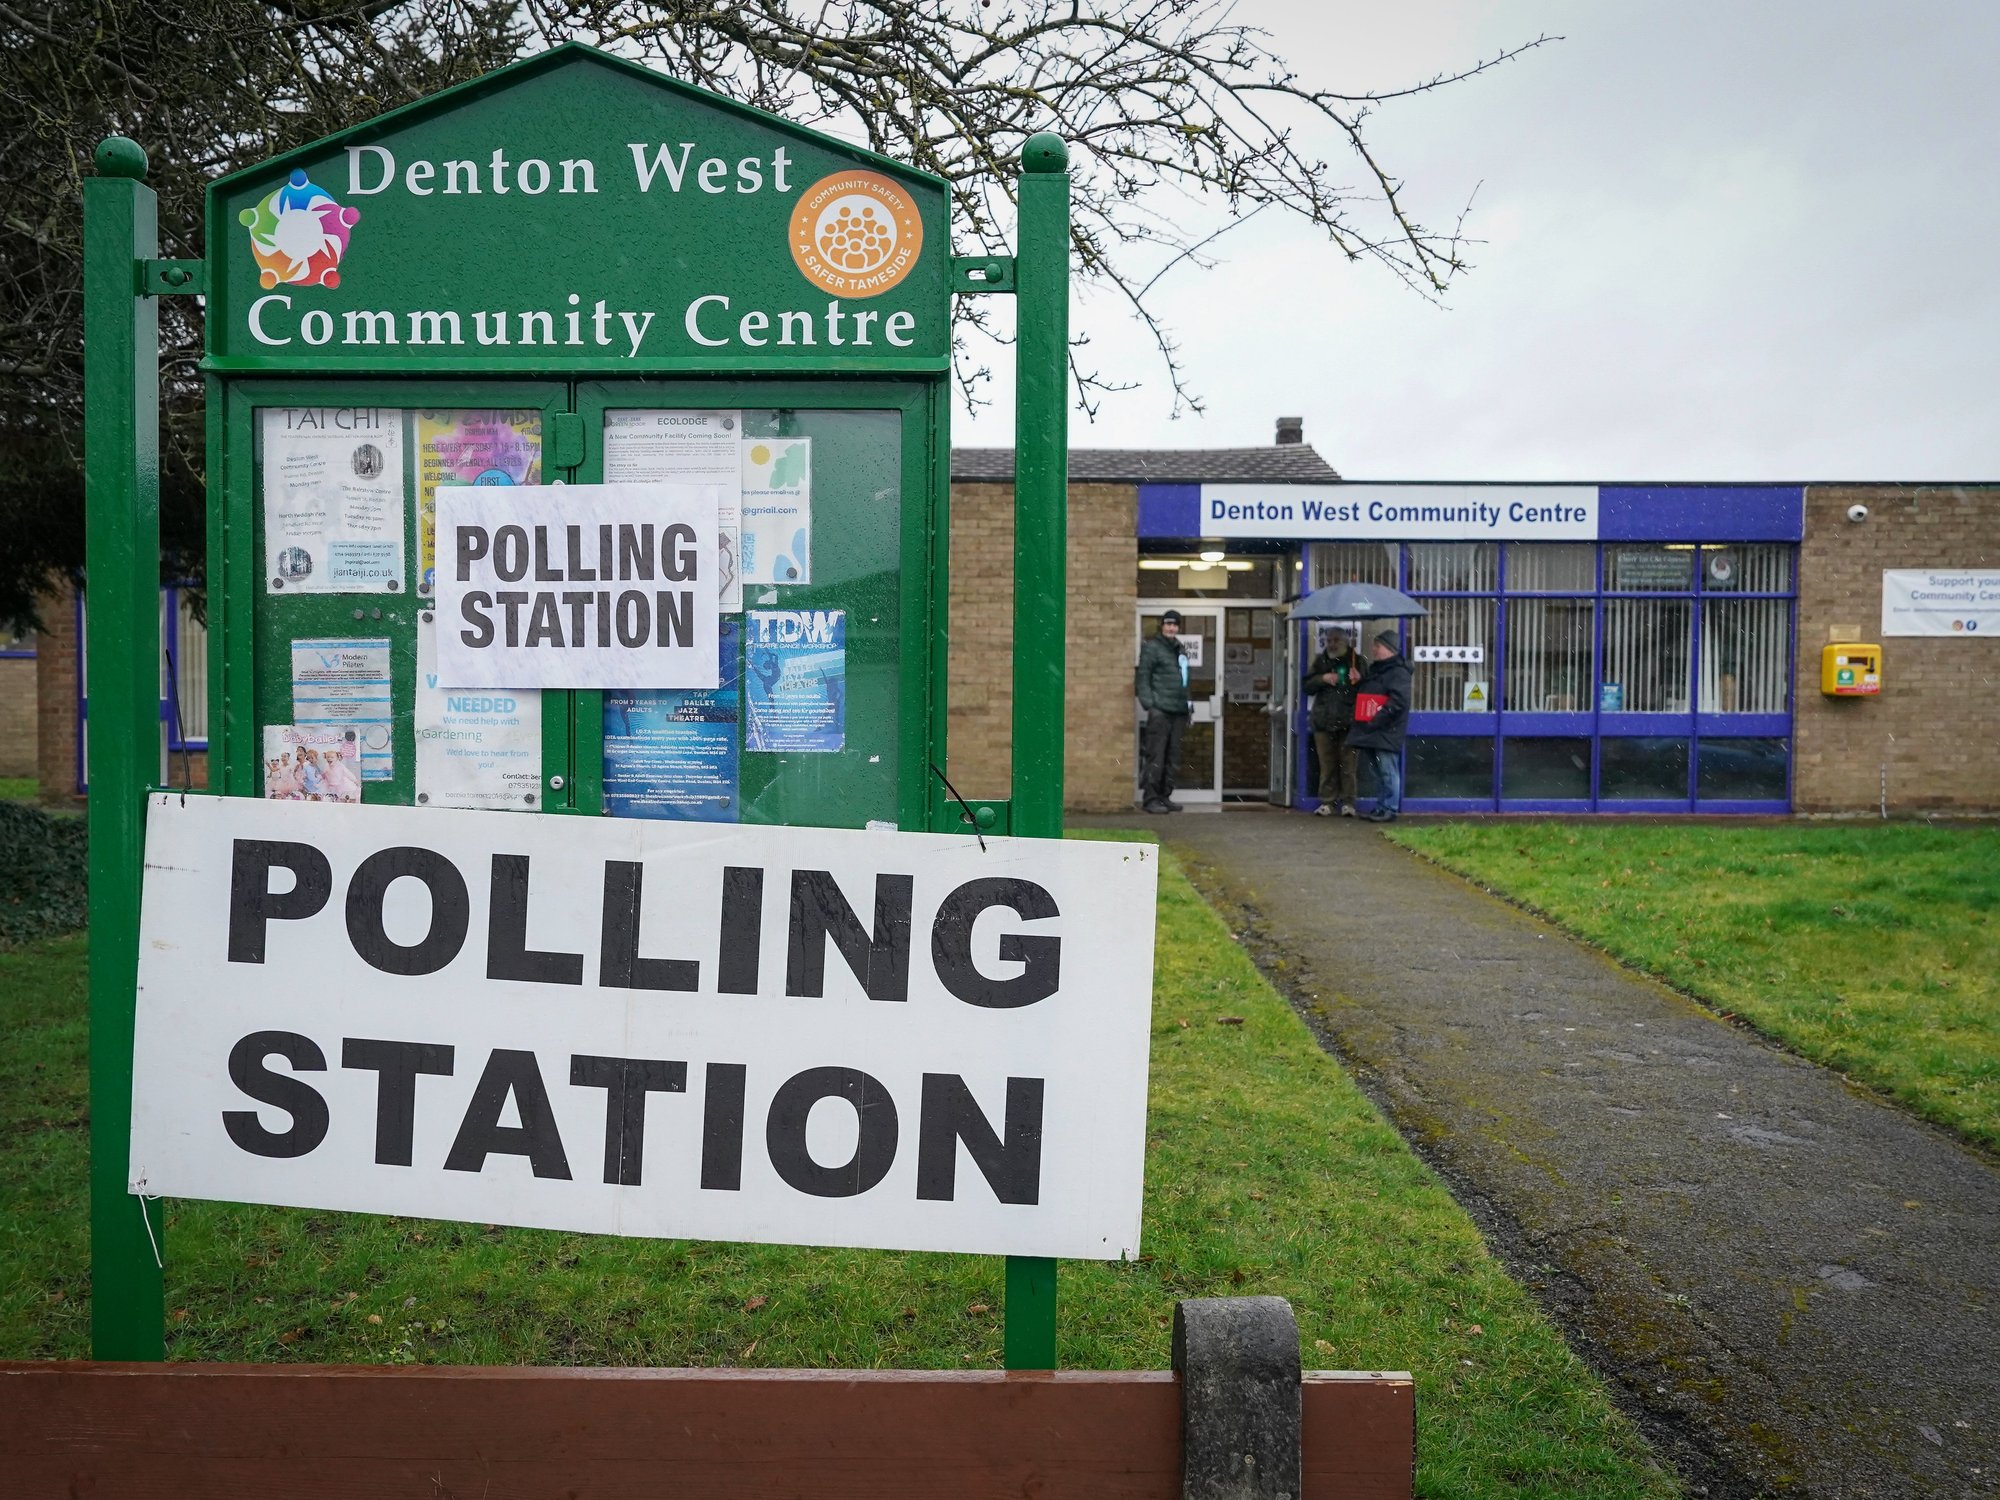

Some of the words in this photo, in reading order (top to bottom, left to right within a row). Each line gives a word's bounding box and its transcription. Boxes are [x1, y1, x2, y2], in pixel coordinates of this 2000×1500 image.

[344, 145, 598, 196] Denton
[627, 142, 793, 194] West
[810, 181, 869, 209] COMMUNITY
[872, 184, 904, 210] SAFETY
[800, 244, 810, 254] A
[805, 256, 845, 288] SAFER
[849, 247, 911, 290] TAMESIDE
[248, 294, 655, 358] Community
[685, 295, 916, 347] Centre
[335, 408, 379, 430] CHI
[657, 417, 708, 426] ECOLODGE
[665, 432, 686, 440] Facility
[423, 443, 440, 452] HERE
[424, 459, 454, 467] BEGINNER
[424, 472, 456, 481] WELCOME!
[481, 477, 500, 486] FIRST
[1211, 500, 1293, 520] Denton
[1302, 501, 1360, 521] West
[1369, 501, 1500, 527] Community
[1509, 502, 1587, 523] Centre
[457, 524, 697, 582] POLLING
[1929, 576, 1974, 588] Support
[1911, 590, 1975, 602] Community
[461, 590, 694, 648] STATION
[752, 611, 838, 643] TDW
[447, 697, 516, 713] NEEDED
[458, 716, 478, 725] need
[480, 717, 498, 726] help
[500, 717, 520, 725] with
[464, 749, 479, 757] love
[481, 749, 489, 757] to
[491, 749, 508, 757] hear
[510, 749, 529, 757] from
[478, 762, 494, 770] you!
[228, 839, 1061, 1008] POLLING
[222, 1031, 1044, 1205] STATION
